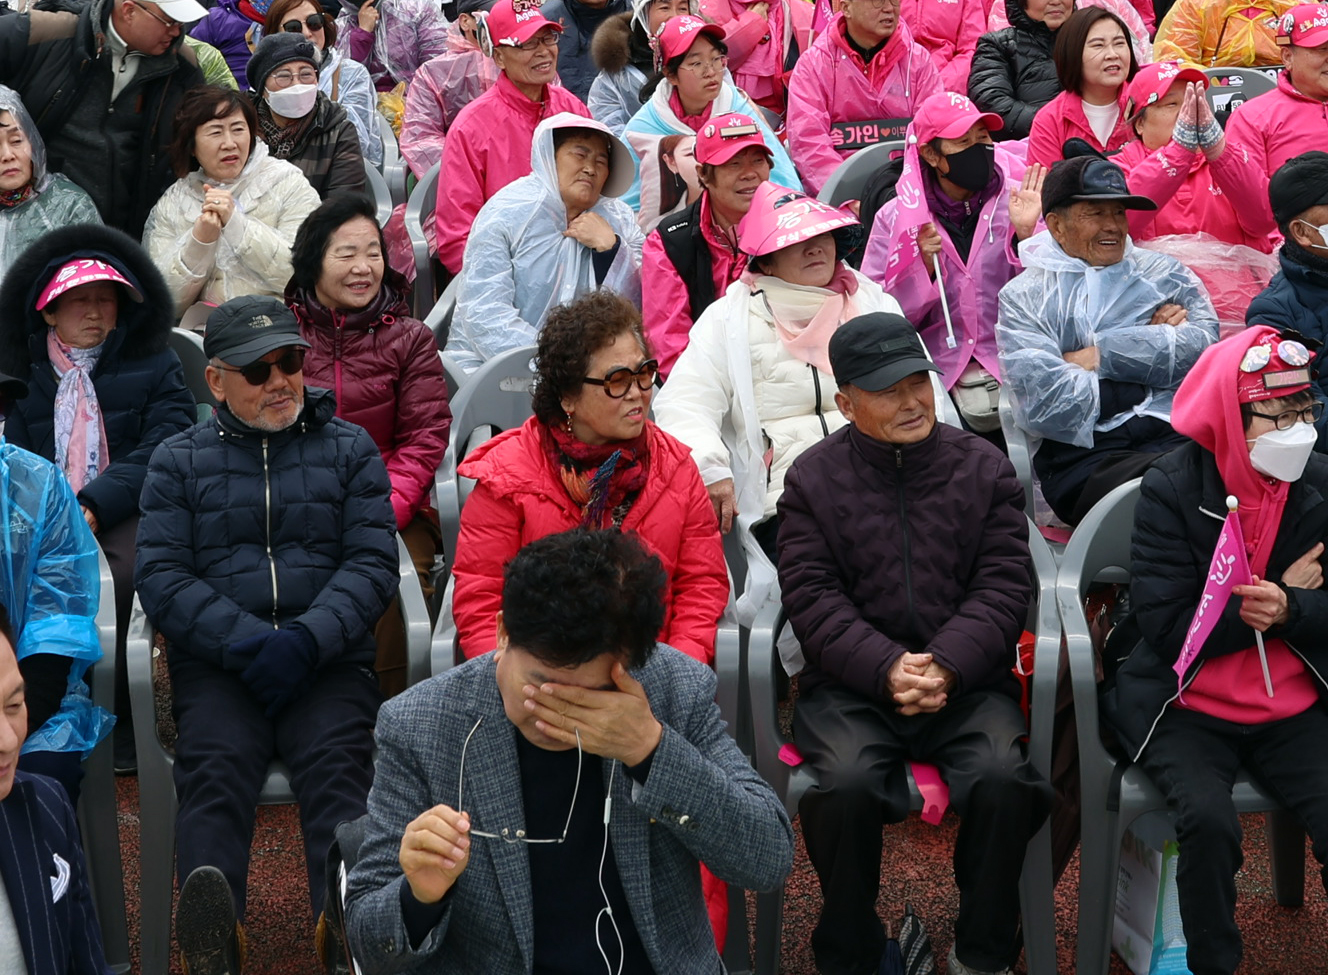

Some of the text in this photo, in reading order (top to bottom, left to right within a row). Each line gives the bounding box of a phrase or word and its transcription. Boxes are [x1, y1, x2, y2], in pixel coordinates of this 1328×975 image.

[516, 11, 541, 23] Again
[678, 22, 704, 34] Again
[830, 124, 879, 145] 송가인
